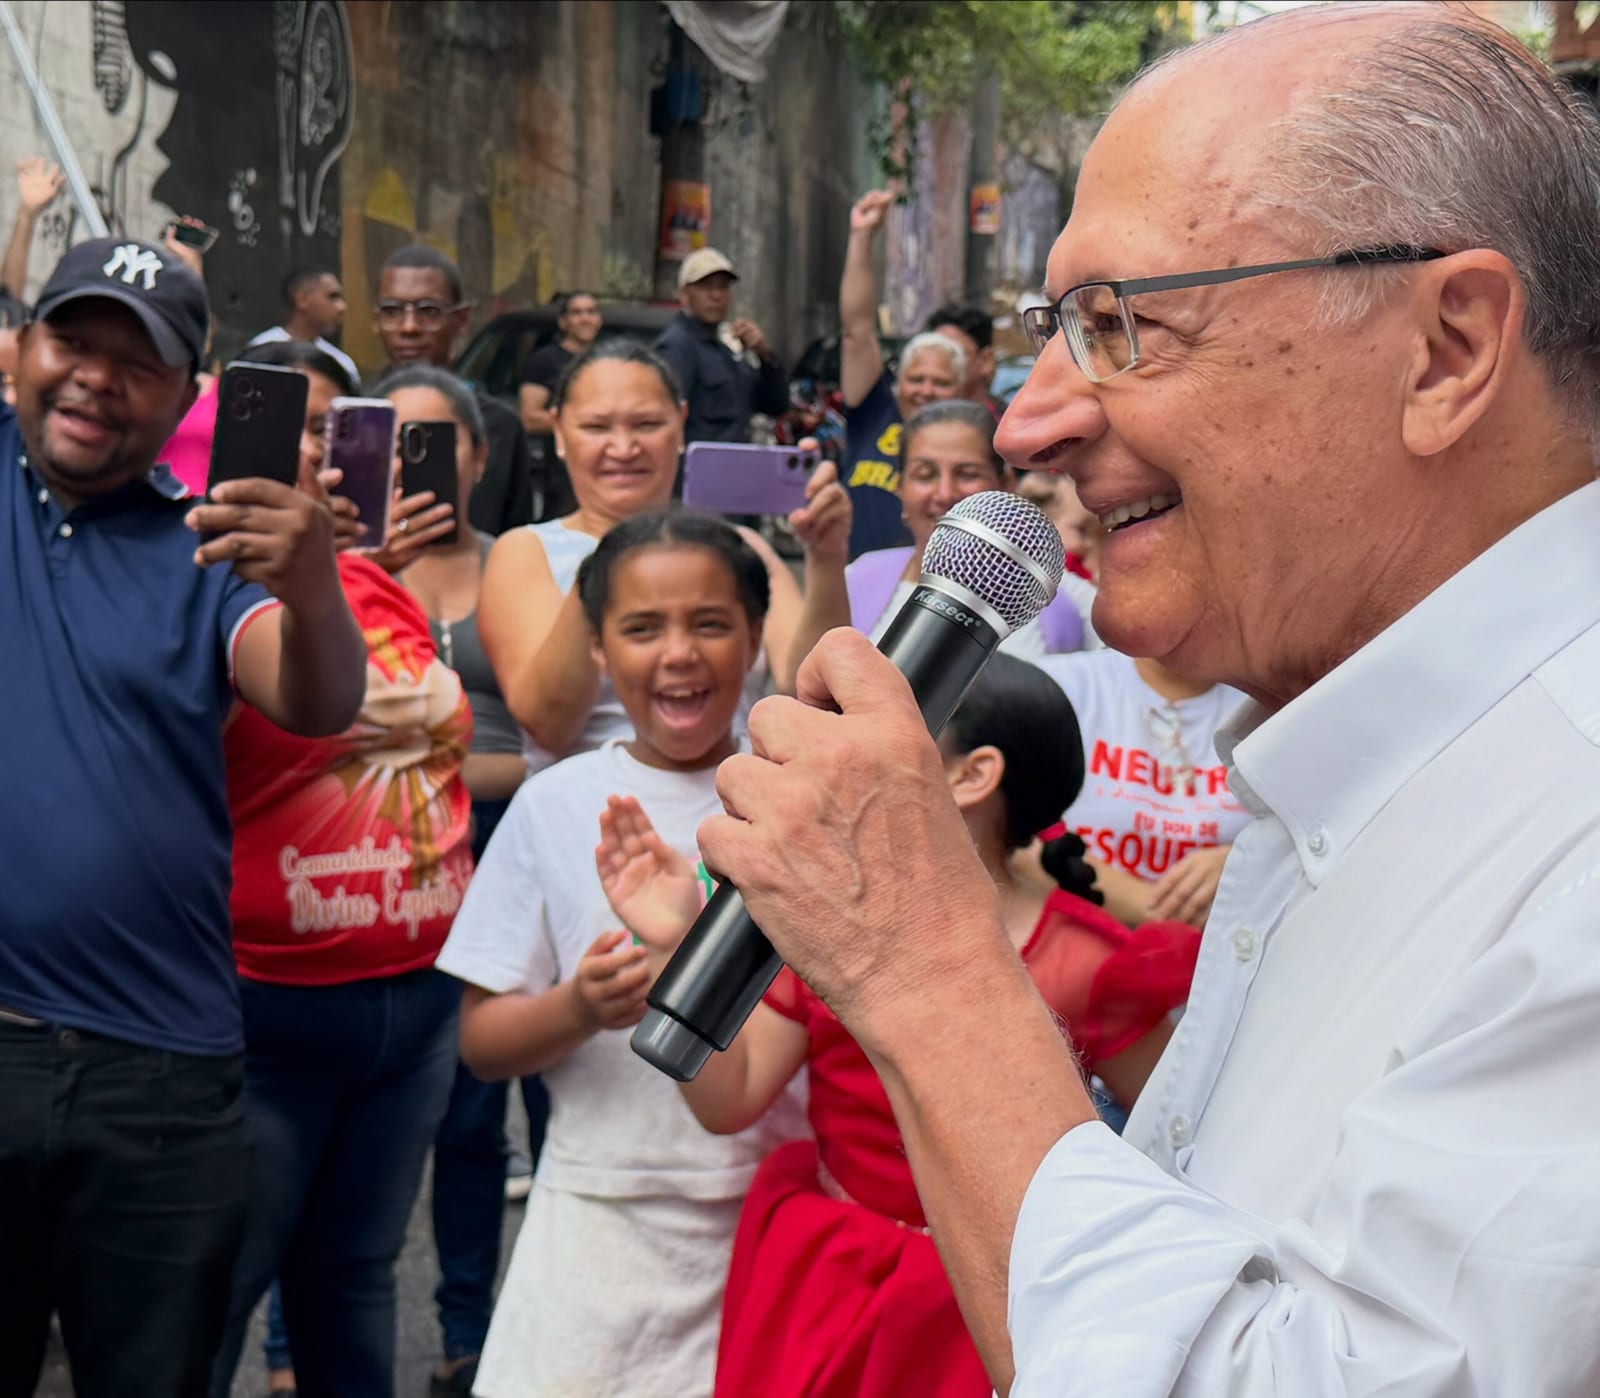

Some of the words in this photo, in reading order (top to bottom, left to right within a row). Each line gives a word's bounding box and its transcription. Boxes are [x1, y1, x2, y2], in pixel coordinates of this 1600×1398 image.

[103, 244, 163, 290] NY
[914, 590, 974, 627] Karsect
[1076, 827, 1217, 879] SQU
